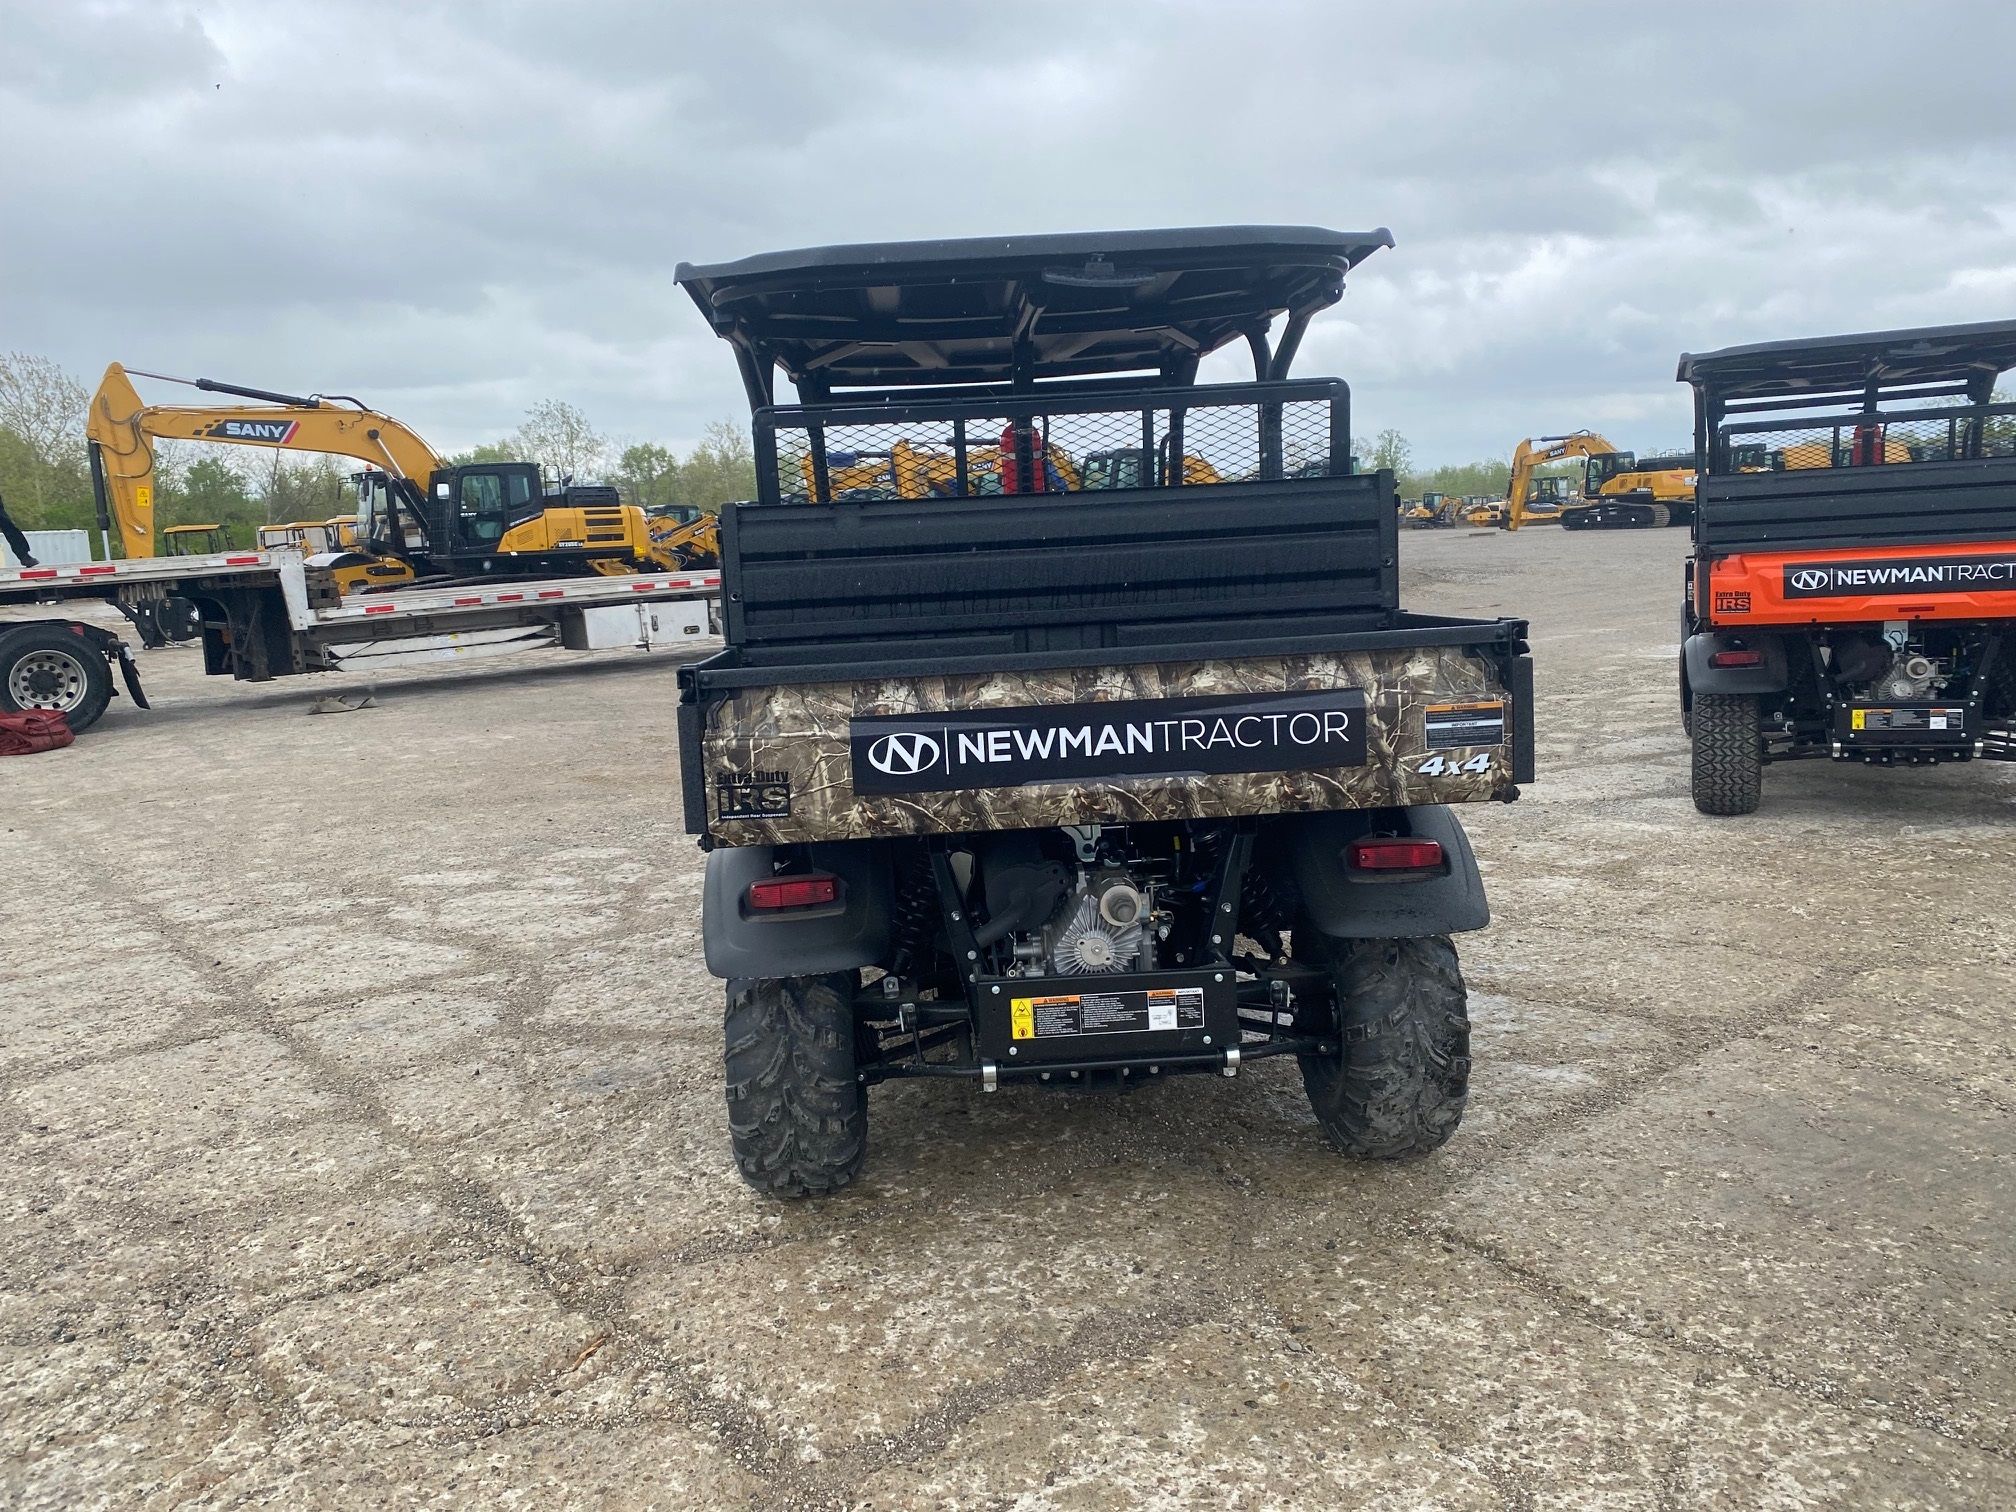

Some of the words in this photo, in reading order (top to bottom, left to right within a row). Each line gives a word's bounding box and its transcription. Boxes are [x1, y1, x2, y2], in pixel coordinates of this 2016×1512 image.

[226, 422, 284, 438] SANY
[1716, 598, 1750, 610] IRS
[958, 711, 1350, 764] NEWMANTRACTOR
[1418, 753, 1491, 777] 4x4
[719, 786, 789, 812] IRS
